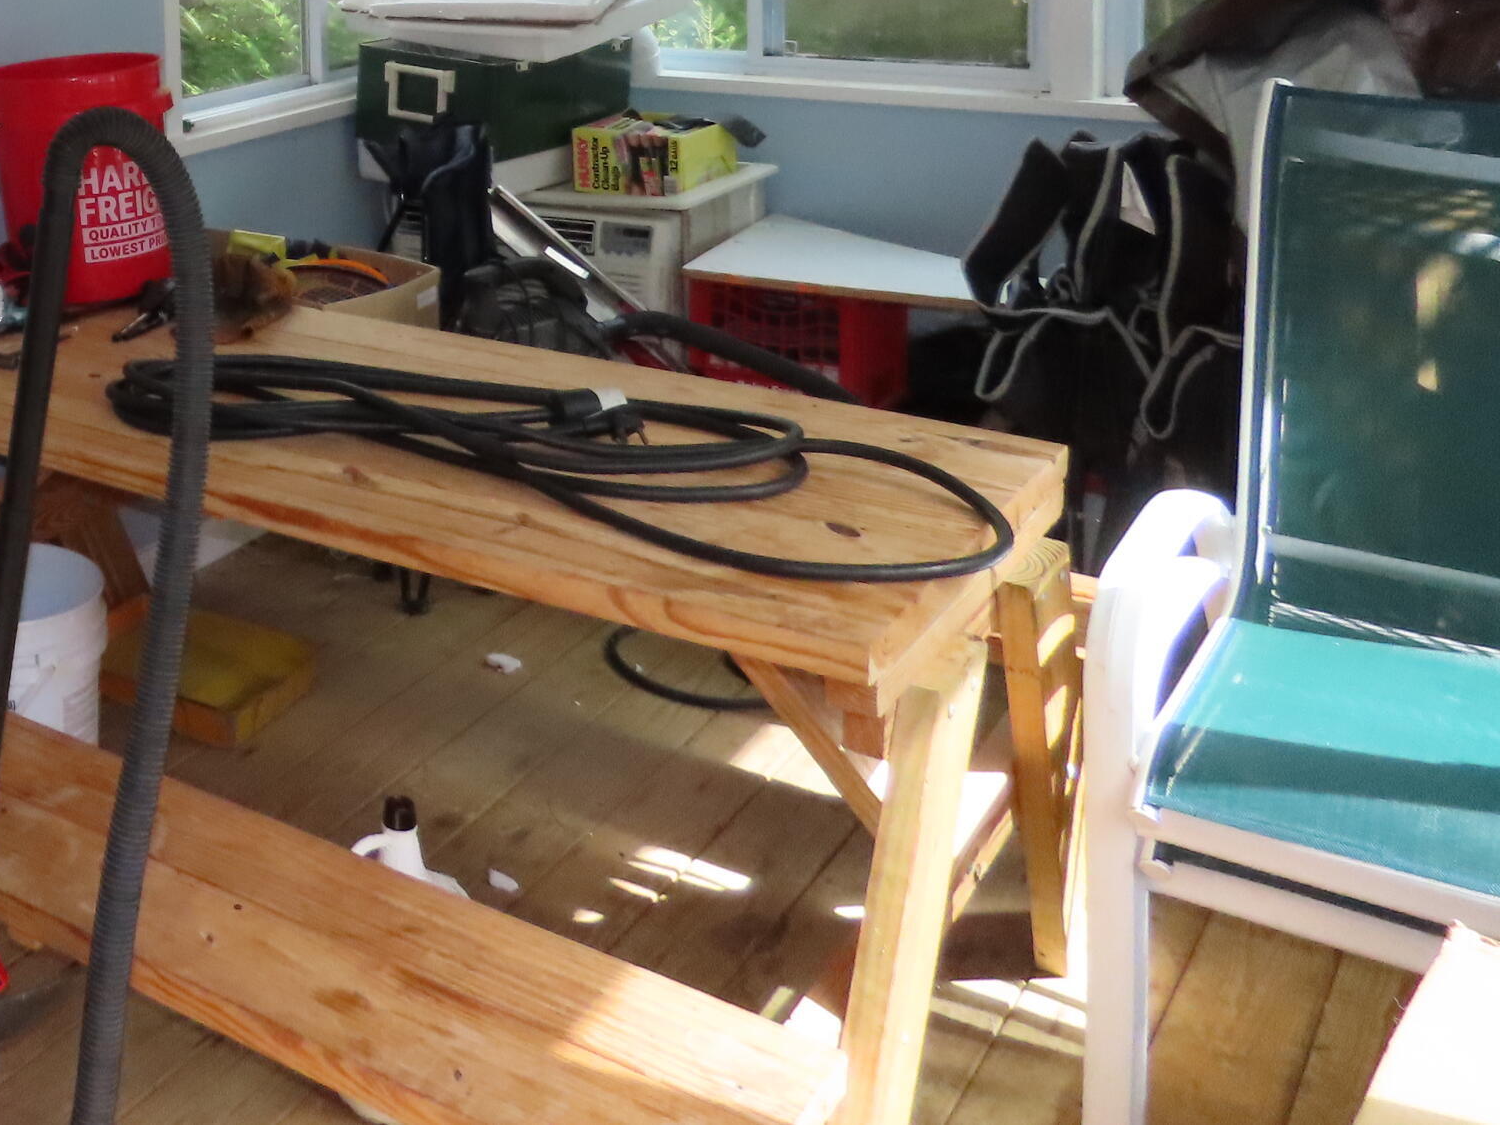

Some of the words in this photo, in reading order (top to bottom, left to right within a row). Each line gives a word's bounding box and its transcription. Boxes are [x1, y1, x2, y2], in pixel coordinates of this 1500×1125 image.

[592, 137, 600, 189] Contractor
[89, 220, 148, 241] QUALITY
[91, 240, 145, 260] LOWEST
